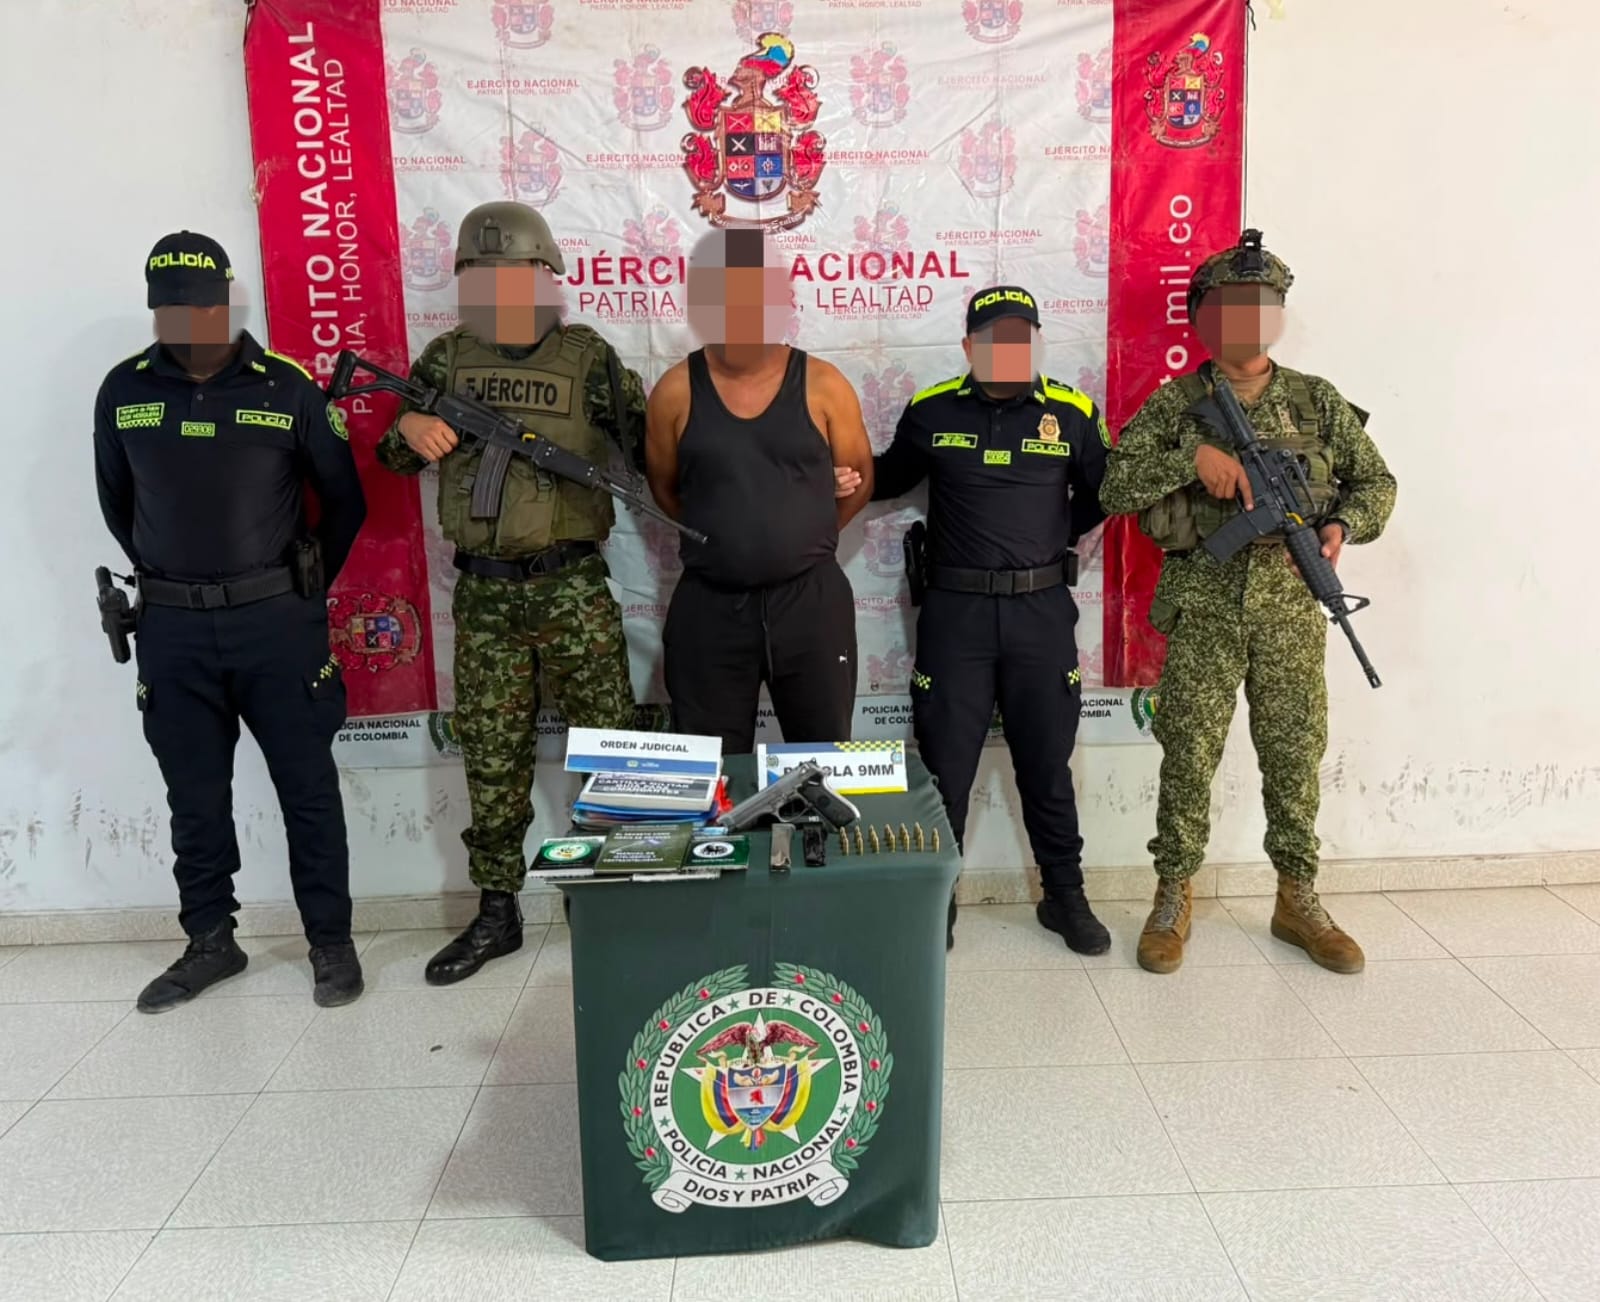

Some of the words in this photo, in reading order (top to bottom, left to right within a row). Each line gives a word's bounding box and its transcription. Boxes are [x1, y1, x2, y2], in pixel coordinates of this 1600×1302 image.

[524, 79, 580, 88] NACIONAL
[323, 58, 352, 181] LEALTAD
[288, 21, 331, 238] NACIONAL
[643, 153, 685, 162] NACION
[990, 229, 1043, 239] NACIONAL
[335, 192, 363, 302] HONOR,
[149, 252, 217, 271] POLICÍA
[555, 249, 686, 287] JÉRCI
[789, 249, 970, 282] ACIONAL
[816, 284, 934, 309] LEALTAD
[1081, 698, 1124, 708] ACIONAL
[862, 705, 900, 715] POLICIA
[367, 719, 422, 730] NACIONAL
[874, 717, 888, 725] DE
[338, 732, 352, 743] DE
[354, 730, 409, 742] COLOMBIA
[600, 740, 638, 750] ORDEN
[640, 742, 690, 753] JUDICIAL
[858, 764, 895, 777] 9MM
[749, 991, 778, 1007] DE
[799, 999, 859, 1095] COLOMBIA
[663, 1129, 728, 1180] POLICÍA
[752, 1116, 848, 1181] NACIONAL
[751, 1171, 820, 1202] PATRIA
